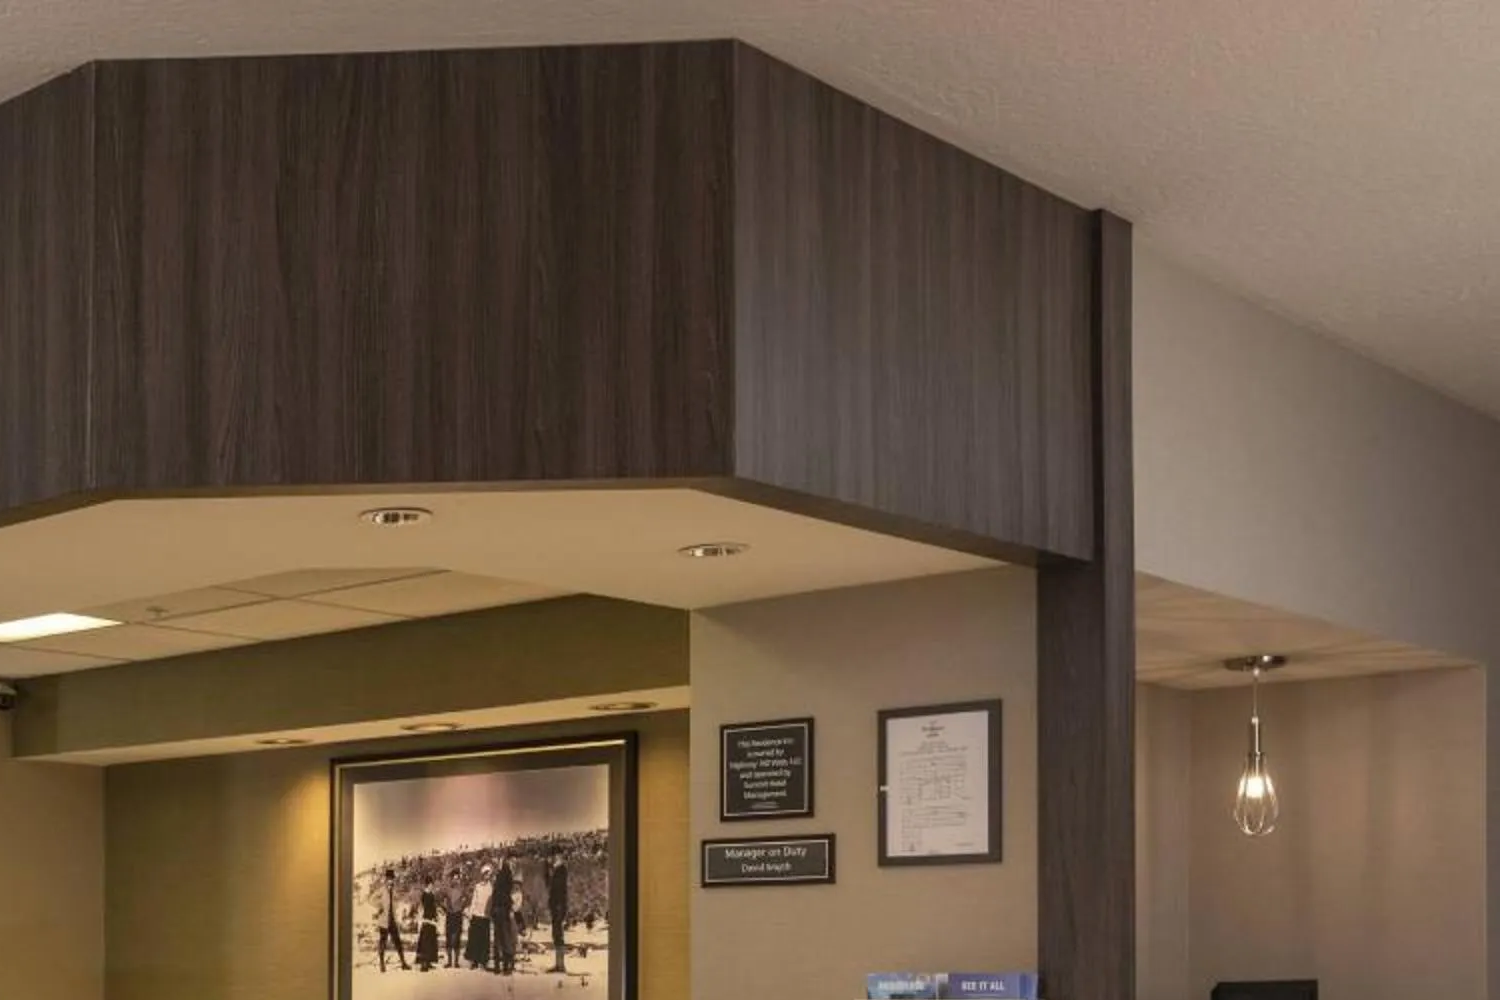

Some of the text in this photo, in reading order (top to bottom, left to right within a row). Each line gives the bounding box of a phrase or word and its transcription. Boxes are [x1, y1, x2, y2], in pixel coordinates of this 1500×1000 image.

[725, 846, 807, 859] Manager on Duty
